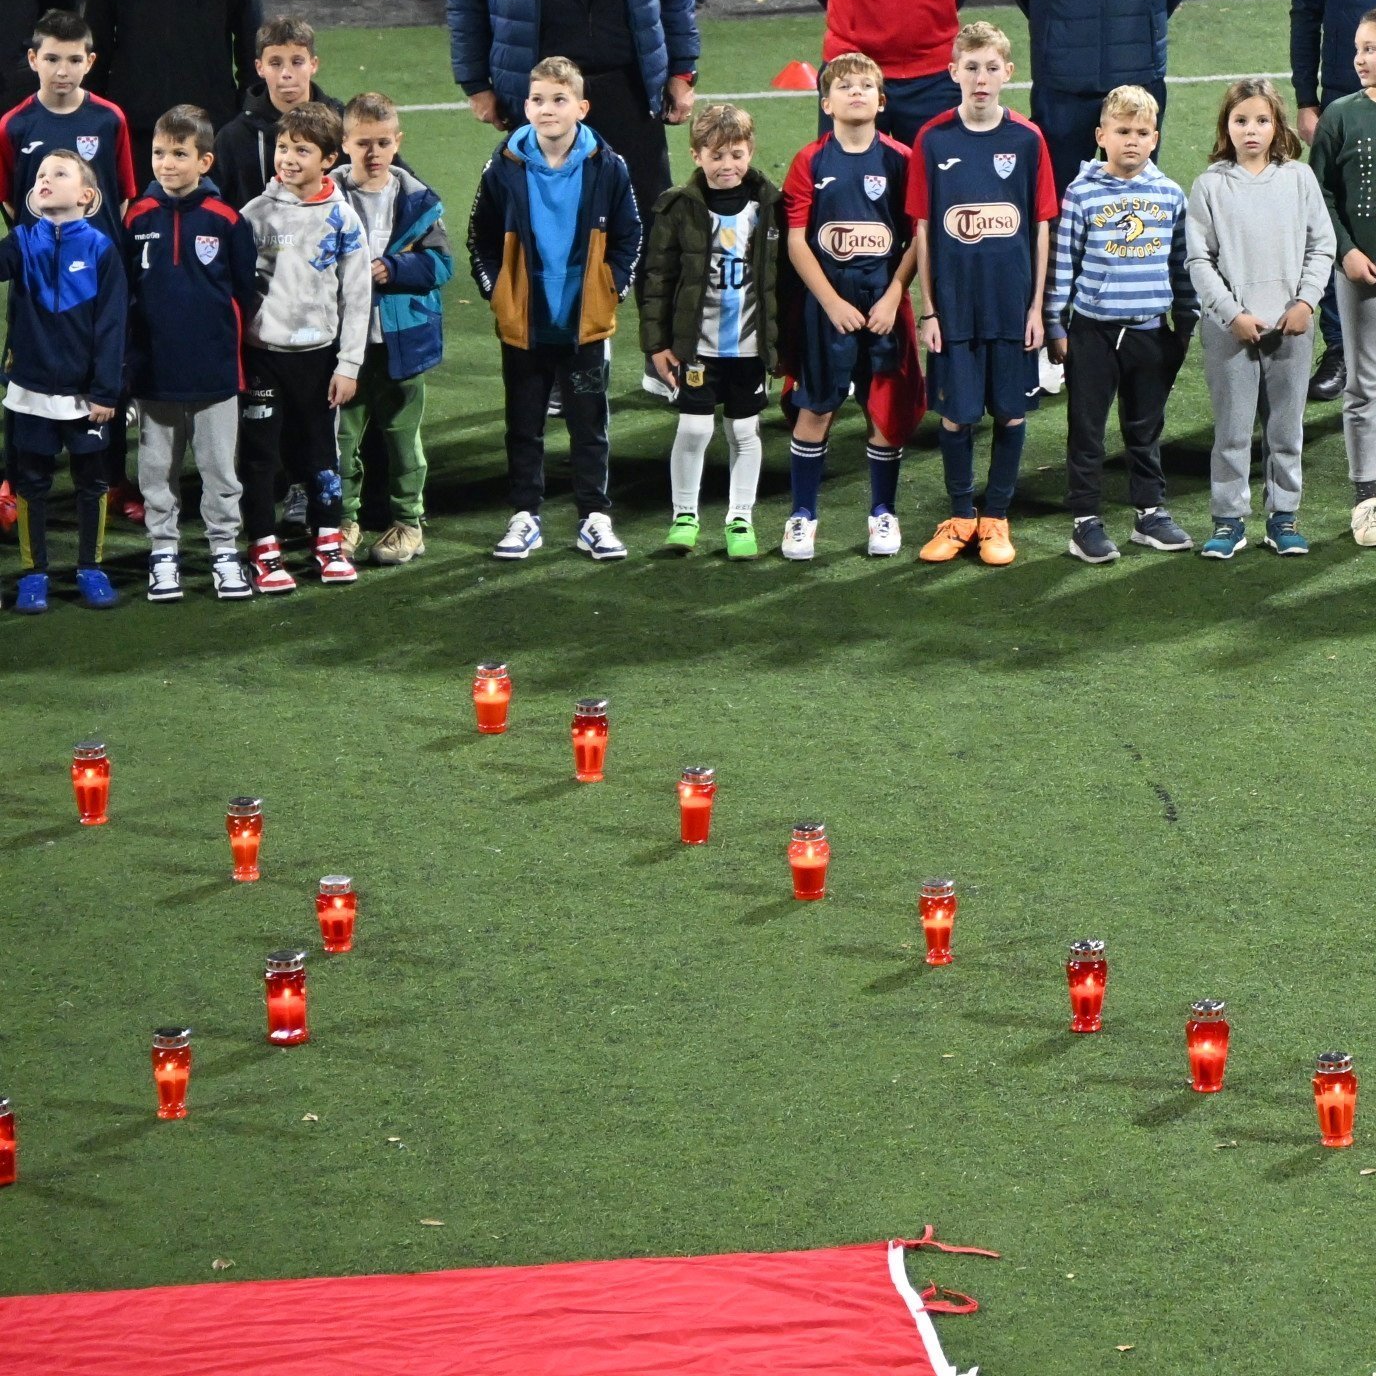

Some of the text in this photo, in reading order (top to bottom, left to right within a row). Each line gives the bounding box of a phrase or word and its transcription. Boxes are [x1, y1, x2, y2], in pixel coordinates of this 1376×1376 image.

[955, 209, 1015, 240] Tarsa
[829, 226, 886, 257] Tarsa
[1105, 237, 1163, 259] MOTORS
[716, 257, 749, 290] 10
